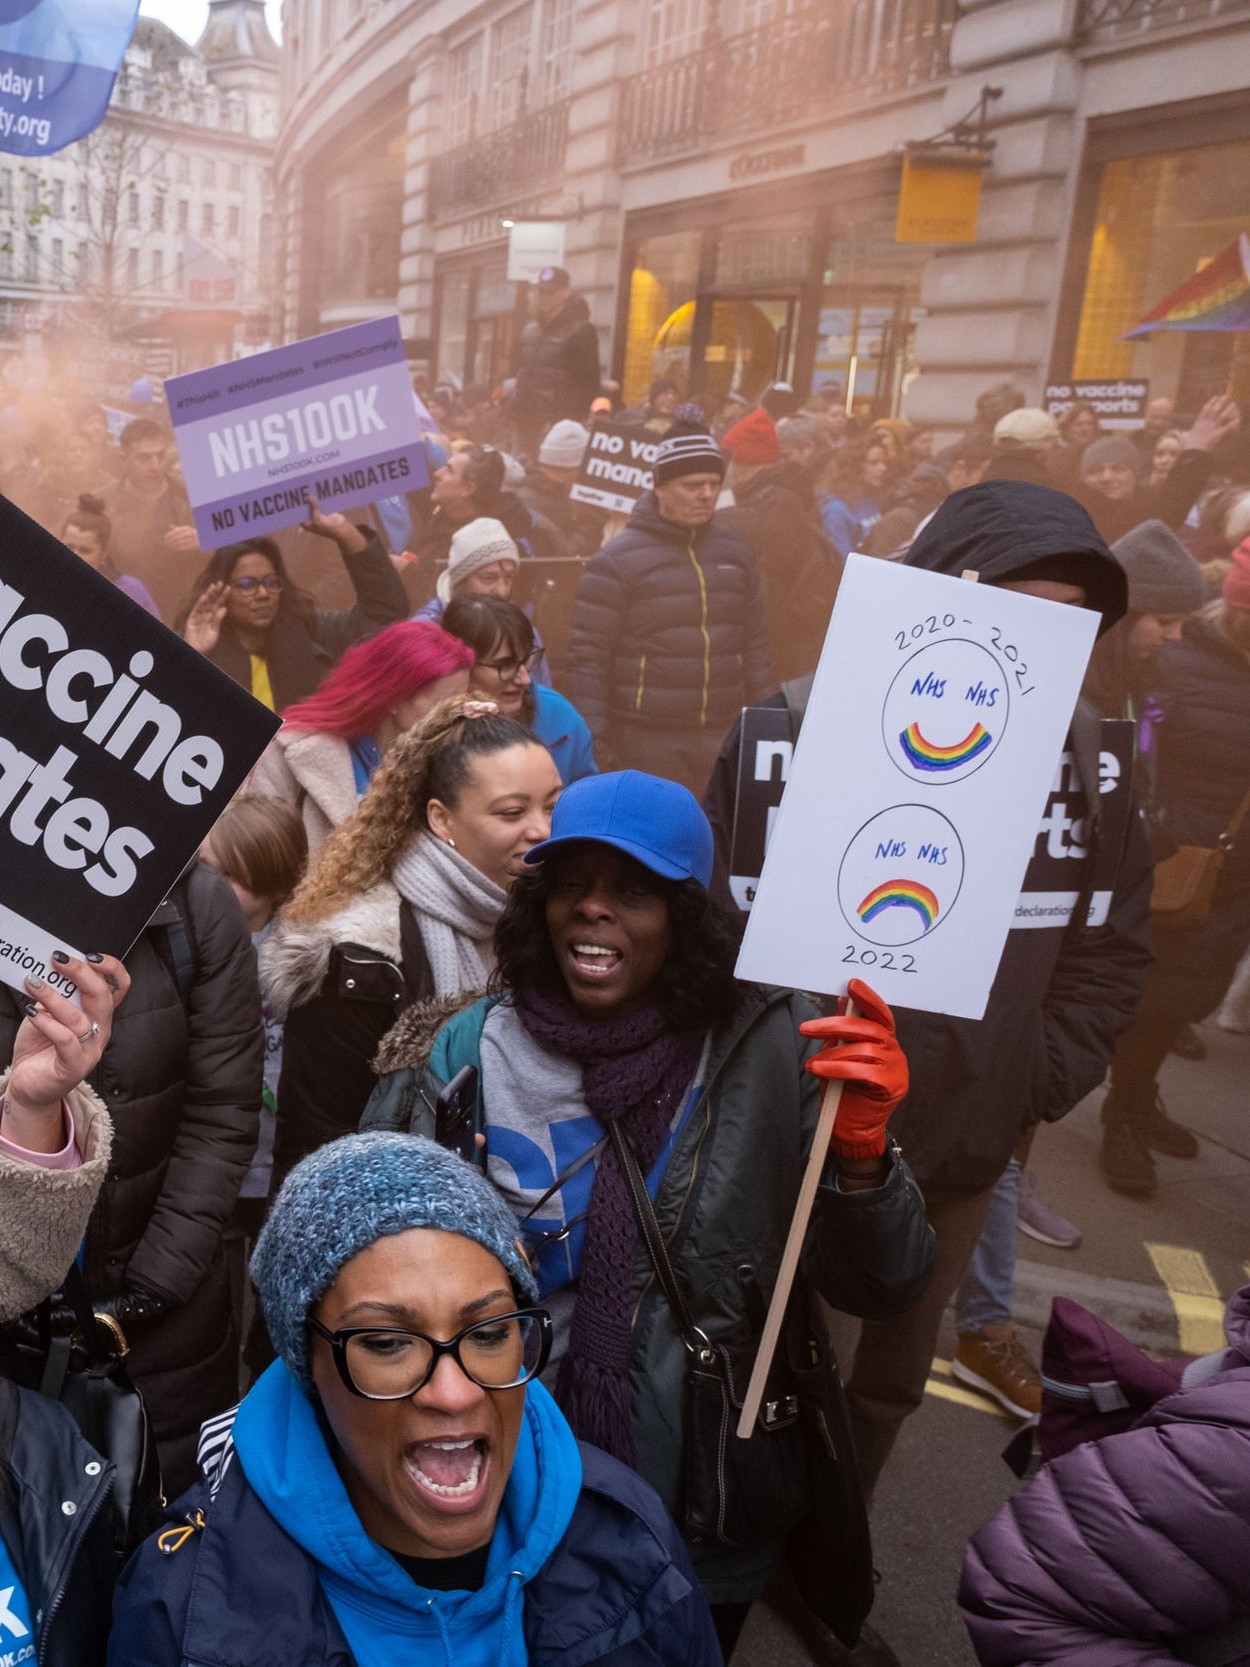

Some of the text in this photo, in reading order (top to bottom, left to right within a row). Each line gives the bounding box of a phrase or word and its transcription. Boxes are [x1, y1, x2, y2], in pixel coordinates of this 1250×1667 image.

[1046, 381, 1146, 398] no vaccine
[208, 385, 386, 478] NHS100K
[591, 432, 624, 453] no
[211, 457, 410, 531] NO VACCINE MANDATES
[991, 627, 1035, 696] 2021
[910, 671, 999, 707] NHS NHS
[875, 839, 948, 865] NHS NHS
[842, 945, 917, 973] 2022
